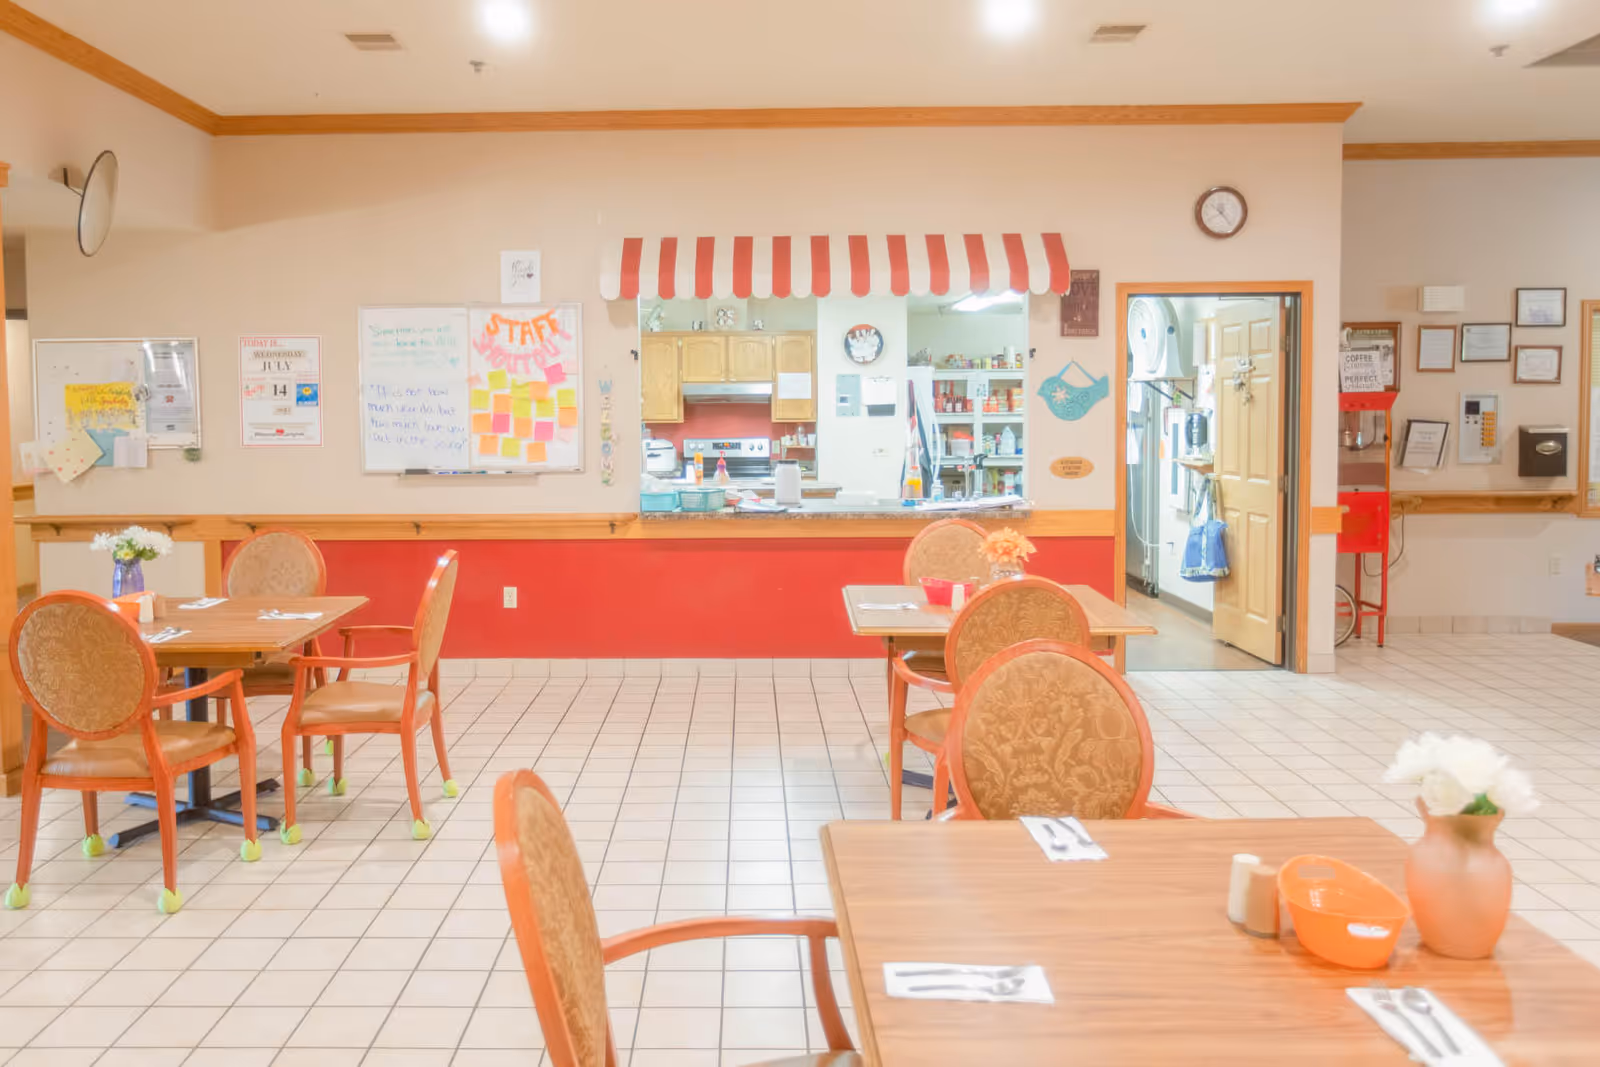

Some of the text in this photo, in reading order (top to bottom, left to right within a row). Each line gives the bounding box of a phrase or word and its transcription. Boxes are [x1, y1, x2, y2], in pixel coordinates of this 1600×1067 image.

[485, 308, 559, 346] STAFF
[243, 339, 269, 348] TODAY
[253, 350, 304, 359] WEDNESDAY
[1344, 354, 1373, 363] COFFEE
[261, 361, 293, 372] JULY
[1344, 375, 1378, 383] PERFECT
[273, 384, 288, 397] 14
